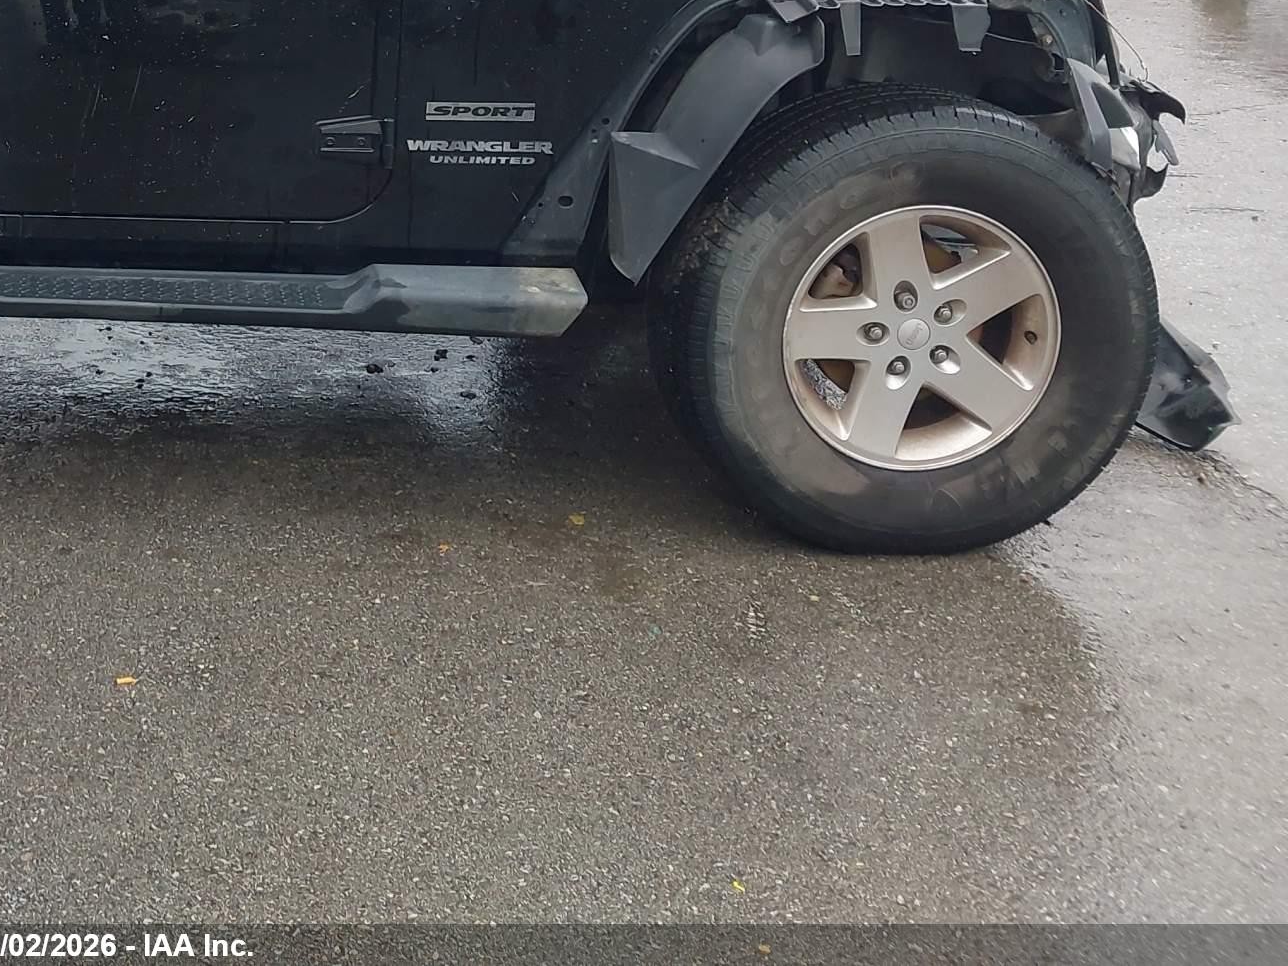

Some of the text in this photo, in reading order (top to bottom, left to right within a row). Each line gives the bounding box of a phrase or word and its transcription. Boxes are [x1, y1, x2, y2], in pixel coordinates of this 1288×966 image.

[428, 105, 533, 117] SPORT
[407, 139, 554, 155] WRANGLER
[429, 155, 535, 165] UNLIMITED
